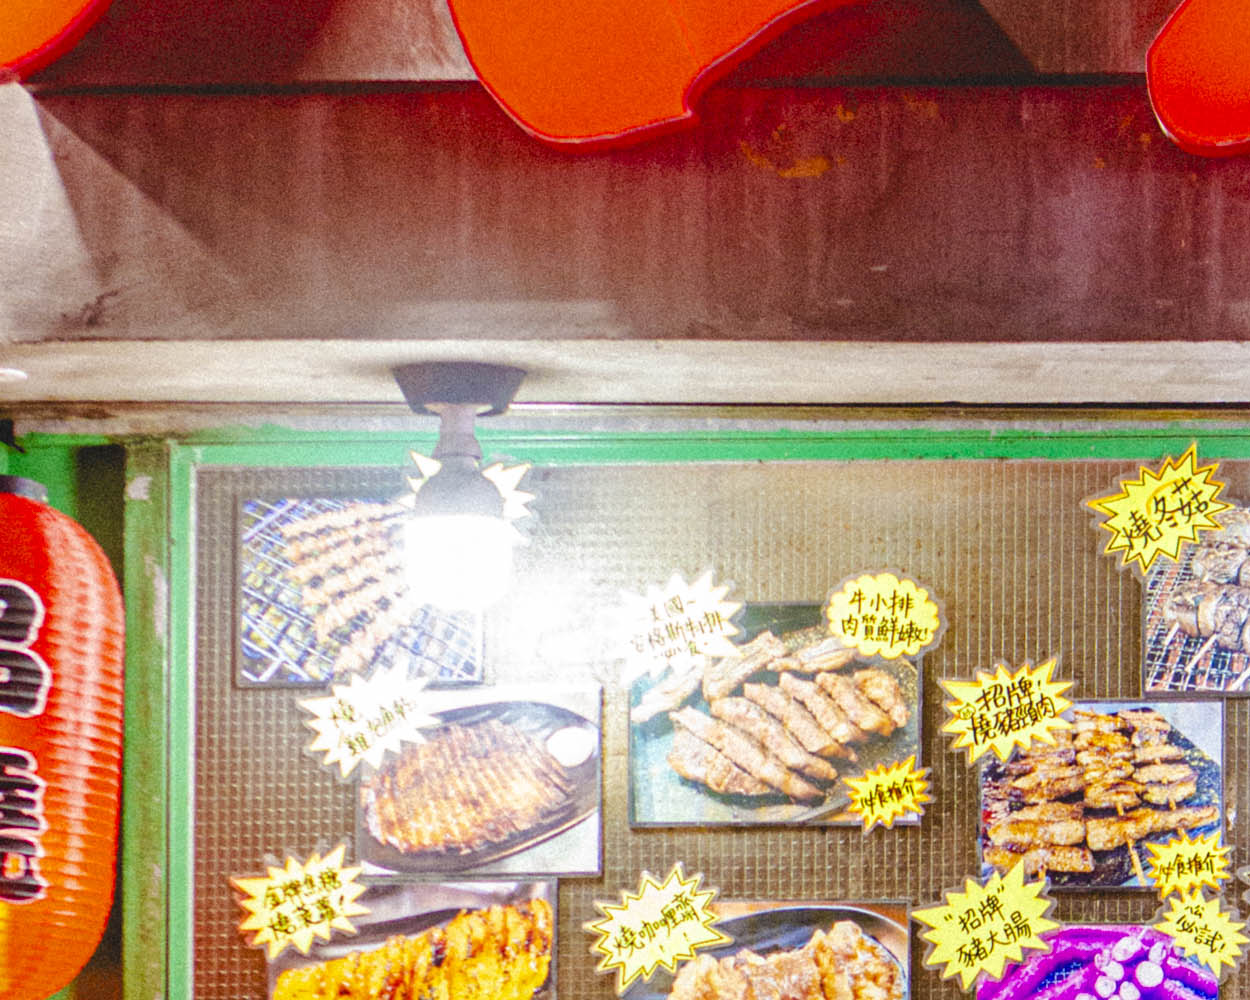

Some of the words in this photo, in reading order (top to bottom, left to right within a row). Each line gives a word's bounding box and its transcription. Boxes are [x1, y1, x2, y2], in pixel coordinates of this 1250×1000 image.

[1121, 476, 1210, 551] 燒冬菇
[848, 588, 914, 618] 牛小排
[956, 910, 1032, 967] 豬大腸
